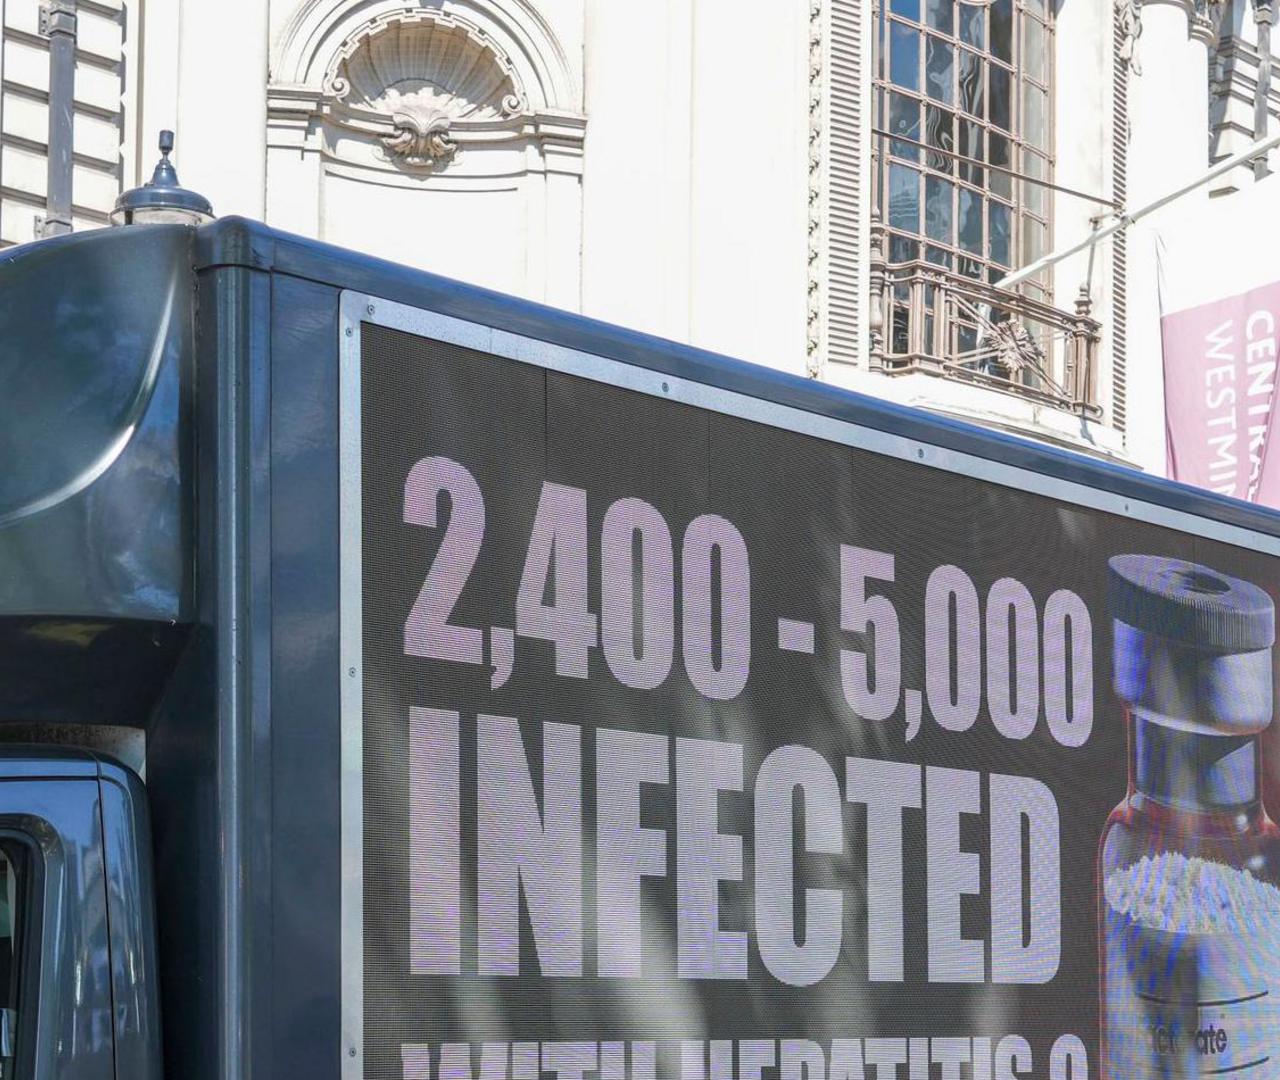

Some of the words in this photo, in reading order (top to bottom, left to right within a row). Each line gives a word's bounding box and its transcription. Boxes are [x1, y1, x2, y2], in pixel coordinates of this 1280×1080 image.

[403, 456, 750, 700] 2,400
[840, 543, 1094, 748] 5,000
[409, 706, 1062, 987] INFECTED
